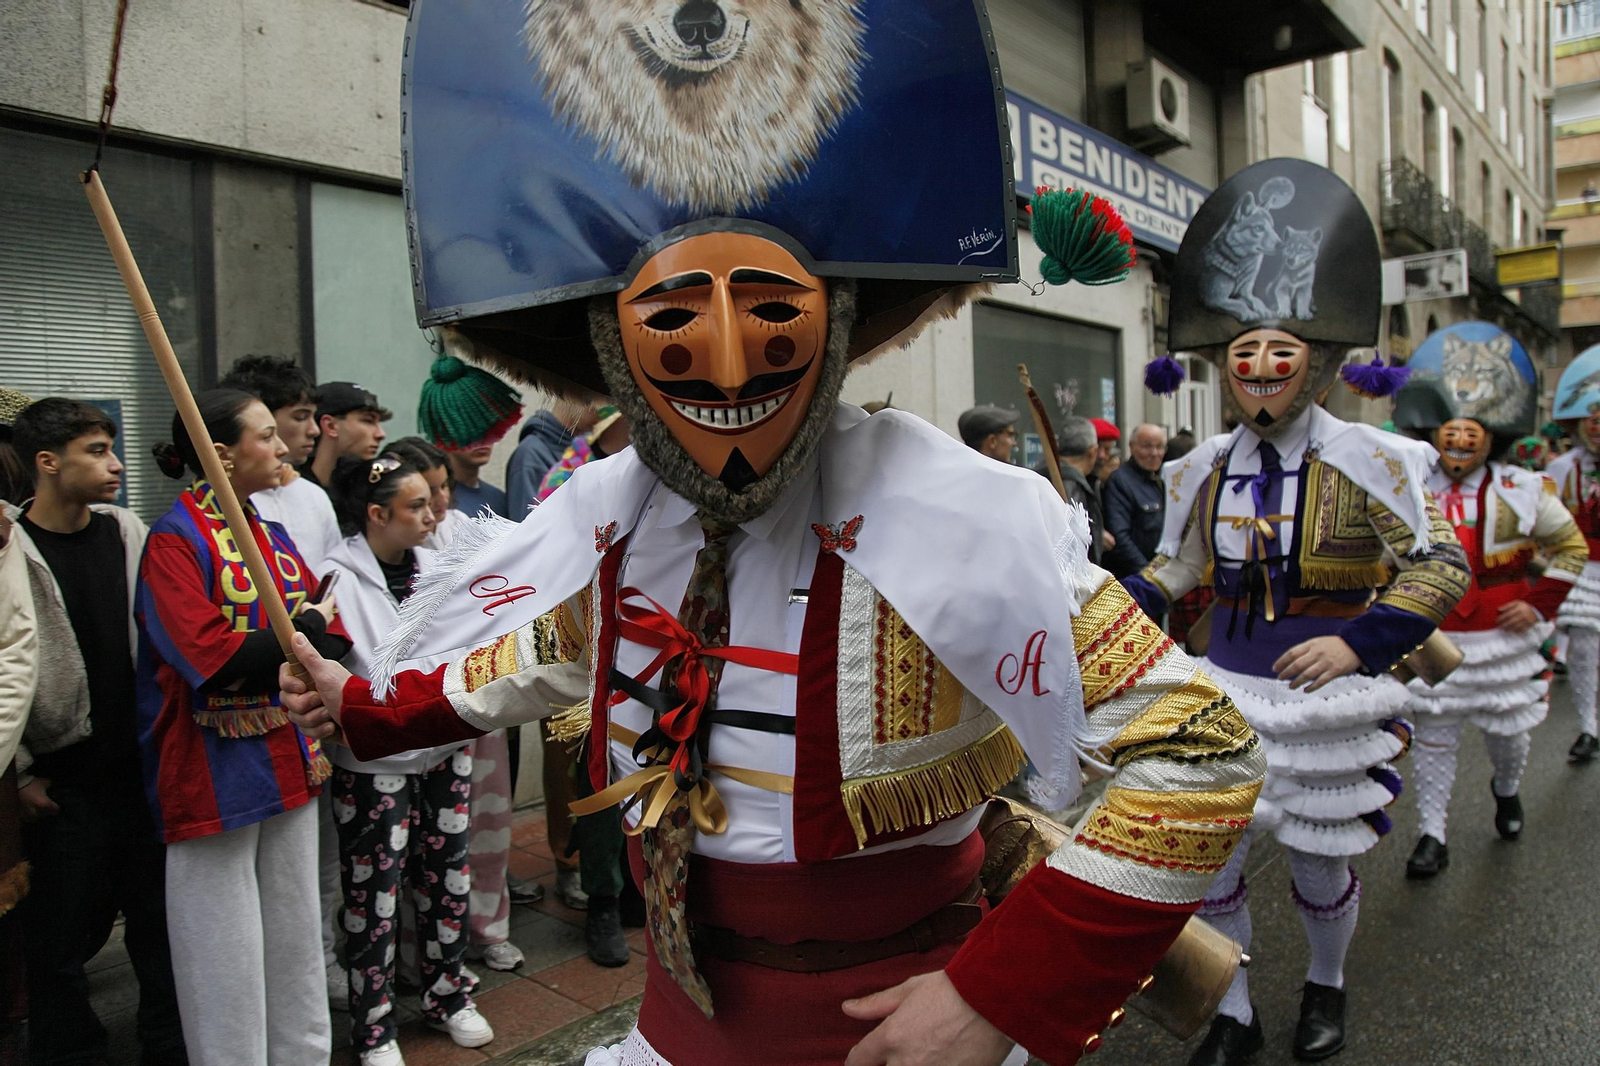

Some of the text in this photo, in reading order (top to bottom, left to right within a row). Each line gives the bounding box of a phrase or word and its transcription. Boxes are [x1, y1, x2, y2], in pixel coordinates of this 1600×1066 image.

[1029, 112, 1205, 218] BENIDENT
[469, 575, 536, 616] A
[996, 630, 1050, 696] A
